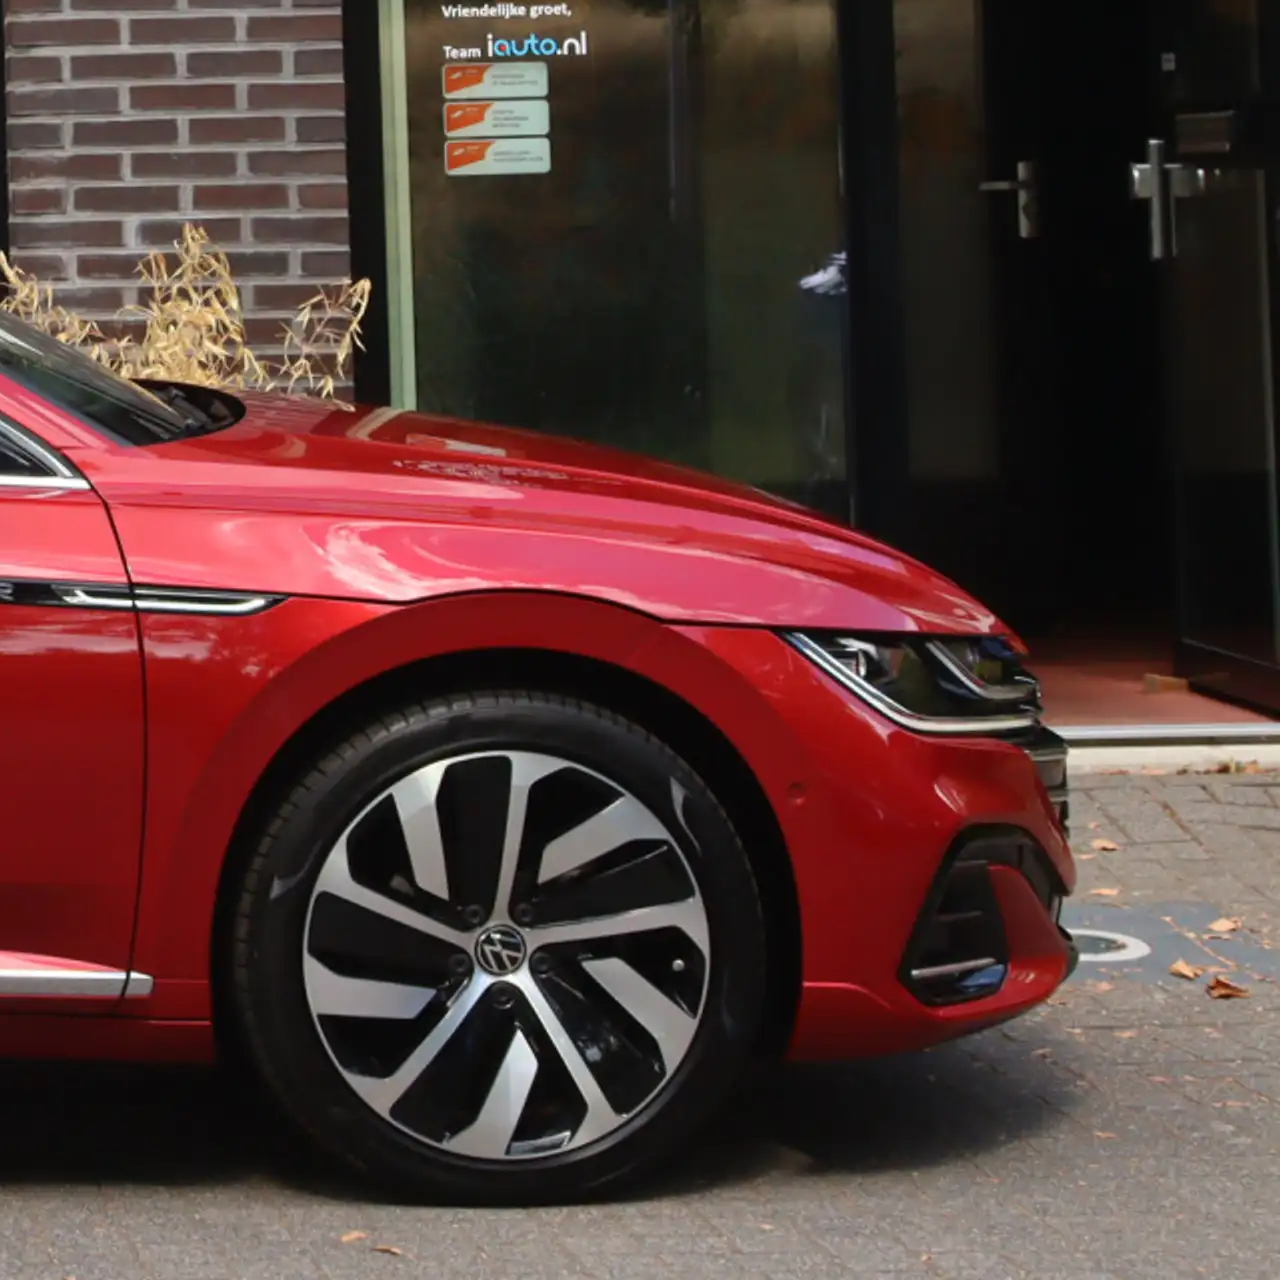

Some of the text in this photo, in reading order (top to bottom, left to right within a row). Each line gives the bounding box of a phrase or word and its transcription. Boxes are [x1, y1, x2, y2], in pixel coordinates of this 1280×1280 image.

[441, 3, 572, 19] Vriendelijke groet,
[442, 29, 588, 59] Team iauto.nl
